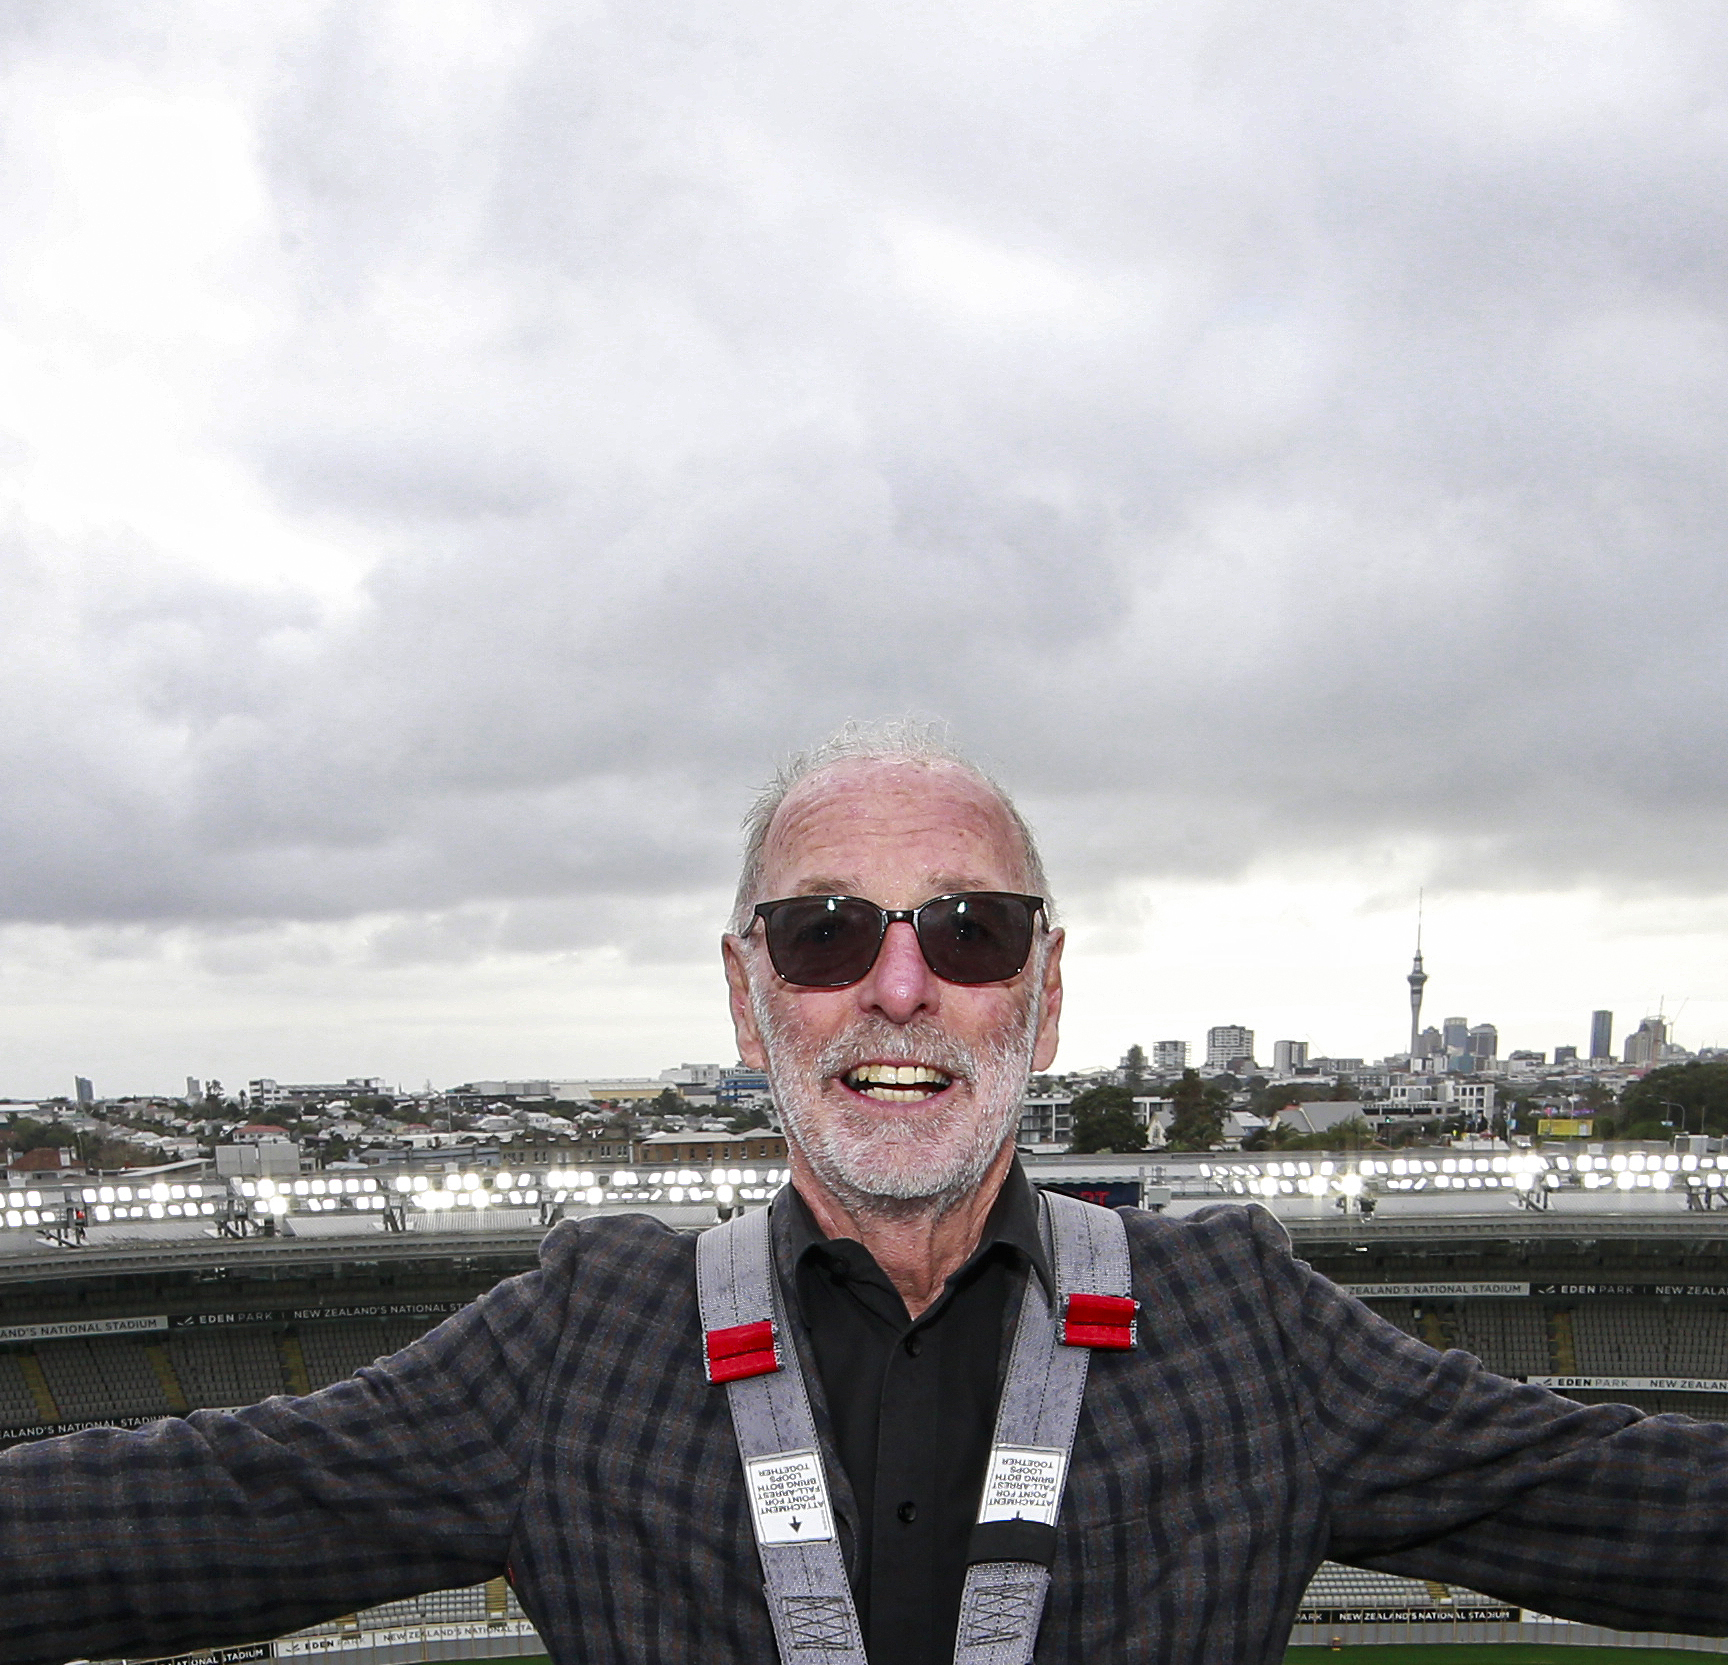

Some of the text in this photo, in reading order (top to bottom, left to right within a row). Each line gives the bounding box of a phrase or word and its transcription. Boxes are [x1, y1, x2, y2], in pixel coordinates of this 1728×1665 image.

[1349, 1284, 1521, 1296] ZEALAND'S NATIONAL STADIUM
[1561, 1285, 1596, 1294] EDEN
[1600, 1285, 1634, 1294] PARK
[1656, 1285, 1684, 1295] NEW
[199, 1314, 234, 1324] EDEN
[238, 1312, 272, 1322] PARK
[294, 1309, 320, 1319] NEW
[325, 1305, 387, 1317] ZEALAND'S
[390, 1303, 445, 1314] NATIONAL
[41, 1323, 102, 1336] NATIONAL
[106, 1319, 157, 1331] STADIUM
[1558, 1377, 1591, 1387] EDEN
[1595, 1378, 1628, 1388] PARK
[1650, 1379, 1677, 1388] NEW
[58, 1420, 116, 1434] NATIONAL
[1002, 1459, 1053, 1468] TOGETHER
[759, 1464, 809, 1476] TOGETHER
[770, 1473, 801, 1482] LOOPS
[1024, 1475, 1054, 1483] BRING
[758, 1478, 816, 1491] BRING BOTH
[787, 1495, 815, 1504] POINT
[761, 1501, 823, 1514] ATTACHMENT
[1339, 1612, 1361, 1621] NEW
[1364, 1612, 1418, 1621] ZEALAND'S
[1419, 1612, 1467, 1620] NATIONAL
[1468, 1611, 1510, 1620] STADIUM
[305, 1640, 334, 1649] EDEN
[383, 1632, 406, 1642] NEW
[408, 1628, 461, 1639] ZELAND'S
[465, 1625, 511, 1635] NATIONAL
[222, 1649, 263, 1663] STADIUM
